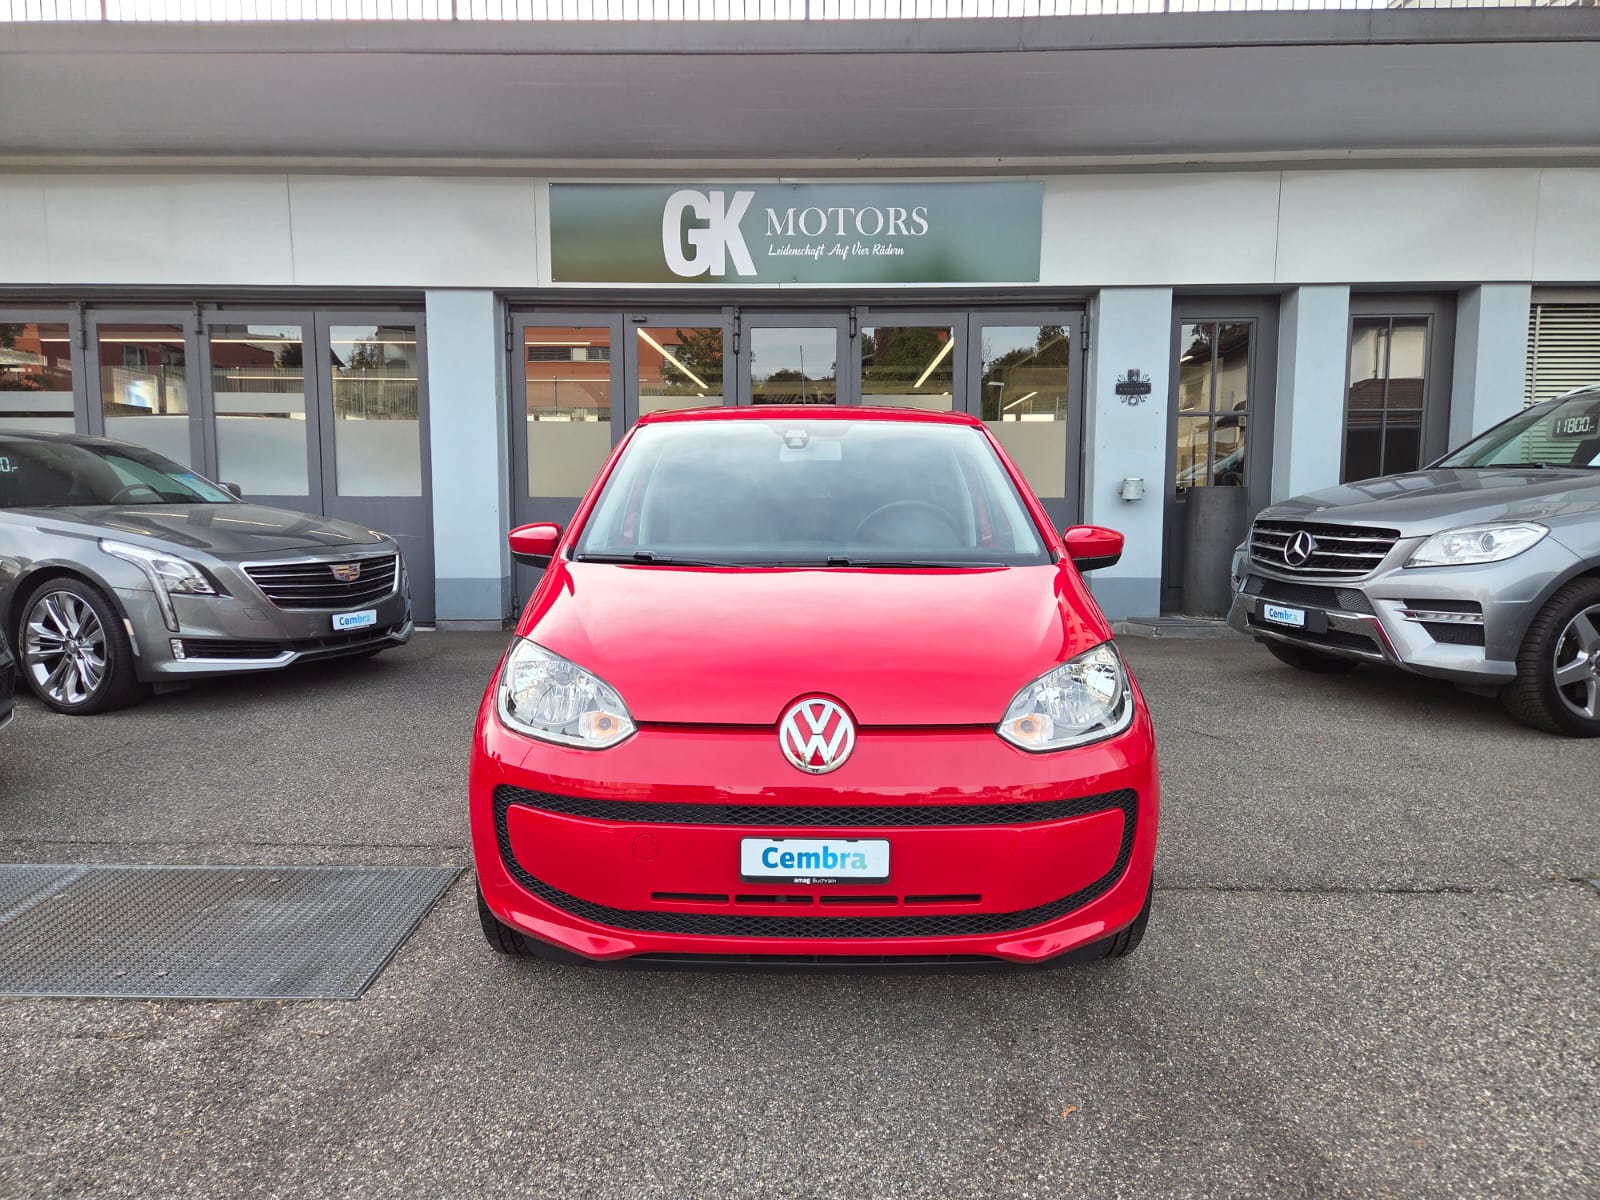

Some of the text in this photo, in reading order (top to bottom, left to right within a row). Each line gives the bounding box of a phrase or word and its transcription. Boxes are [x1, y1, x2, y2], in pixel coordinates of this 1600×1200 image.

[663, 190, 929, 277] GK MOTORS
[768, 241, 905, 261] Leidenschaft Auf Vier Rädern
[338, 614, 371, 626] Cembra
[1268, 608, 1298, 623] Cembra
[761, 845, 868, 870] Cembra
